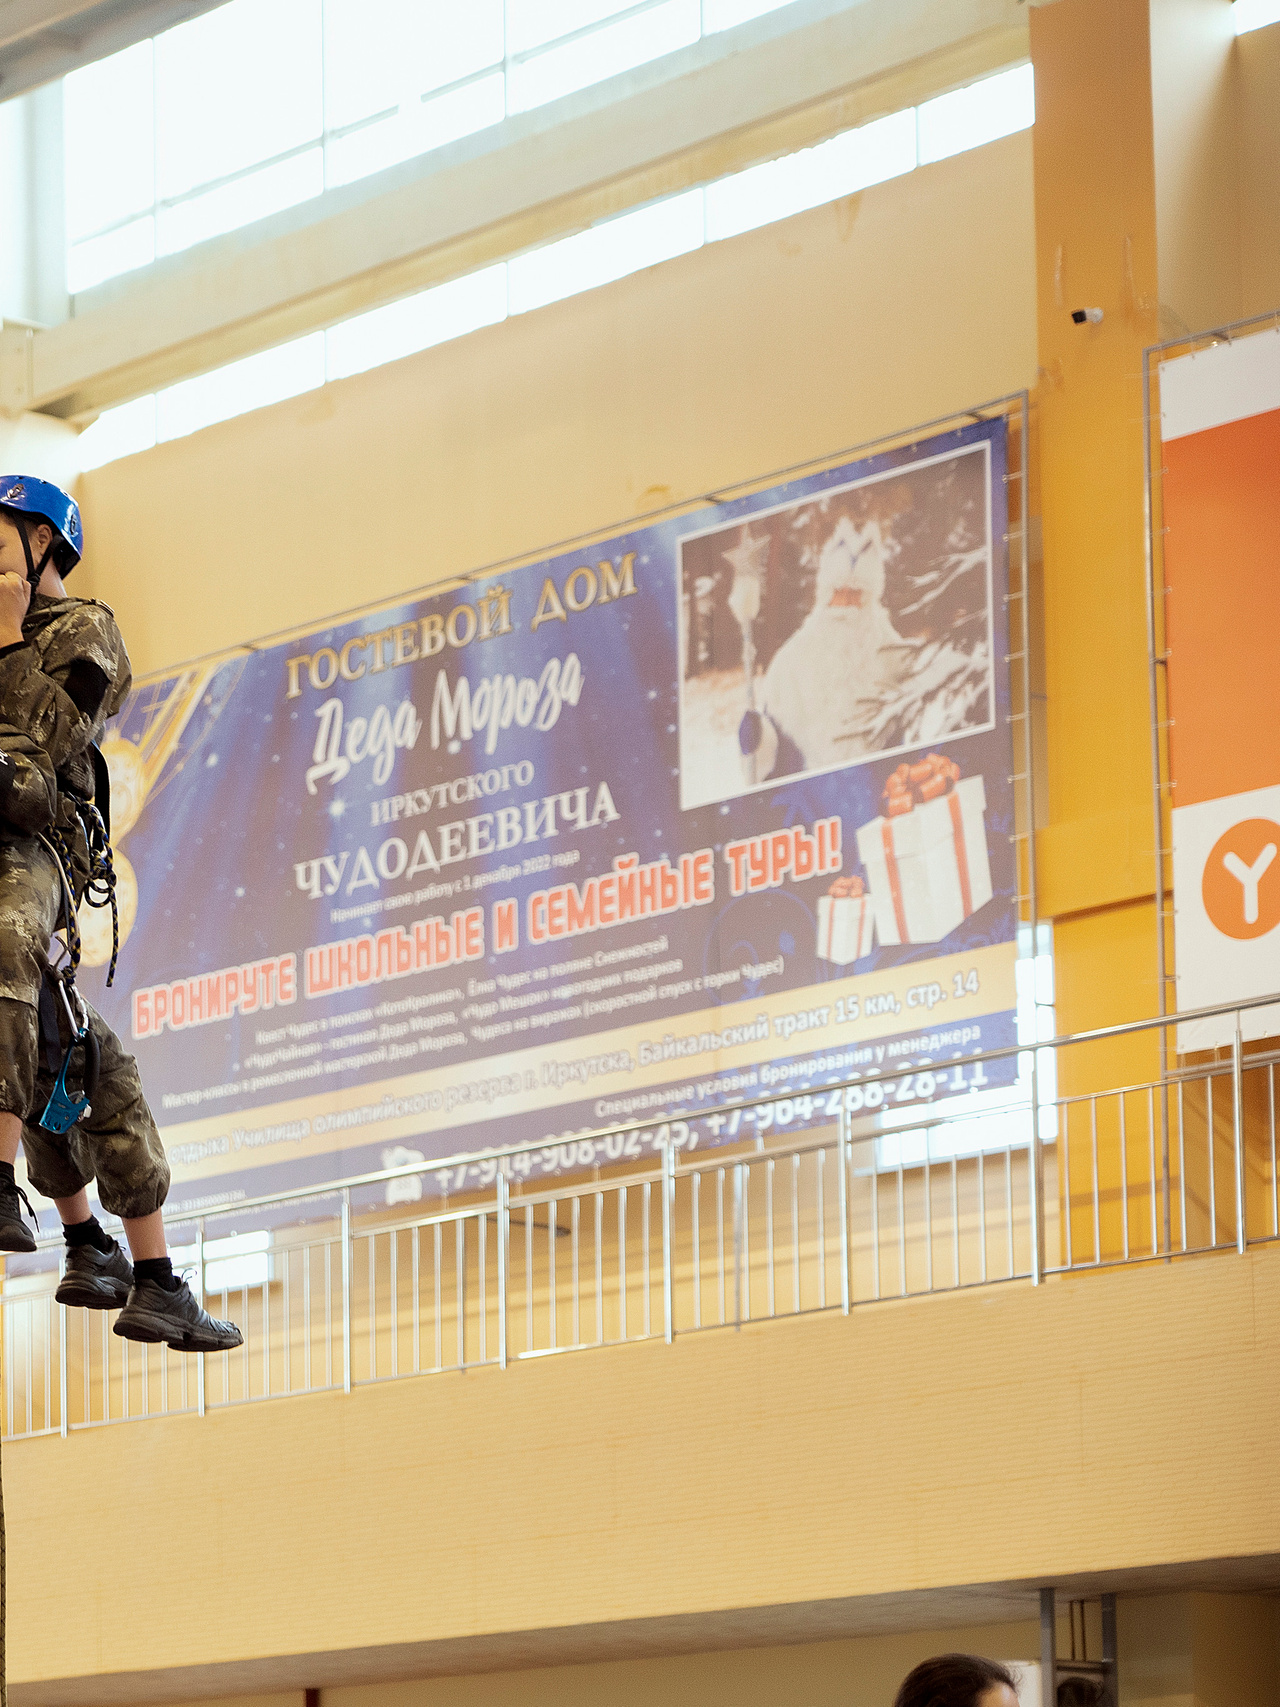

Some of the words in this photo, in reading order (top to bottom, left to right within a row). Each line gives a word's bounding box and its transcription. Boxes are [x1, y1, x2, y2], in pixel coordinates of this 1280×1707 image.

[285, 584, 514, 699] ГОСТЕВОЙ
[531, 552, 638, 632] ДОМ
[306, 697, 422, 795] Деда
[430, 652, 585, 755] Мороза
[293, 781, 620, 900] ЧУДОДЕЕВИЧА
[371, 760, 535, 827] ИРКУТСКОГО
[304, 904, 485, 1000] ШКОЛЬНЫЕ
[492, 897, 520, 955] И
[528, 849, 715, 946] СЕМЕЙНЫЕ
[724, 815, 842, 897] ТУРЫ!
[471, 863, 521, 891] декабря
[552, 849, 581, 870] года
[232, 1114, 312, 1151] Училища
[312, 1090, 443, 1135] олимпийского
[637, 1014, 769, 1068] Байкальский
[773, 1004, 831, 1038] тракт
[835, 995, 861, 1024] 15
[863, 988, 903, 1019] км,
[905, 981, 948, 1013] стр.
[951, 967, 980, 998] 14
[594, 1082, 695, 1119] Специальные
[696, 1071, 758, 1103] условия
[760, 1045, 873, 1087] бронирования
[874, 1044, 888, 1063] у
[887, 1023, 982, 1058] менеджера
